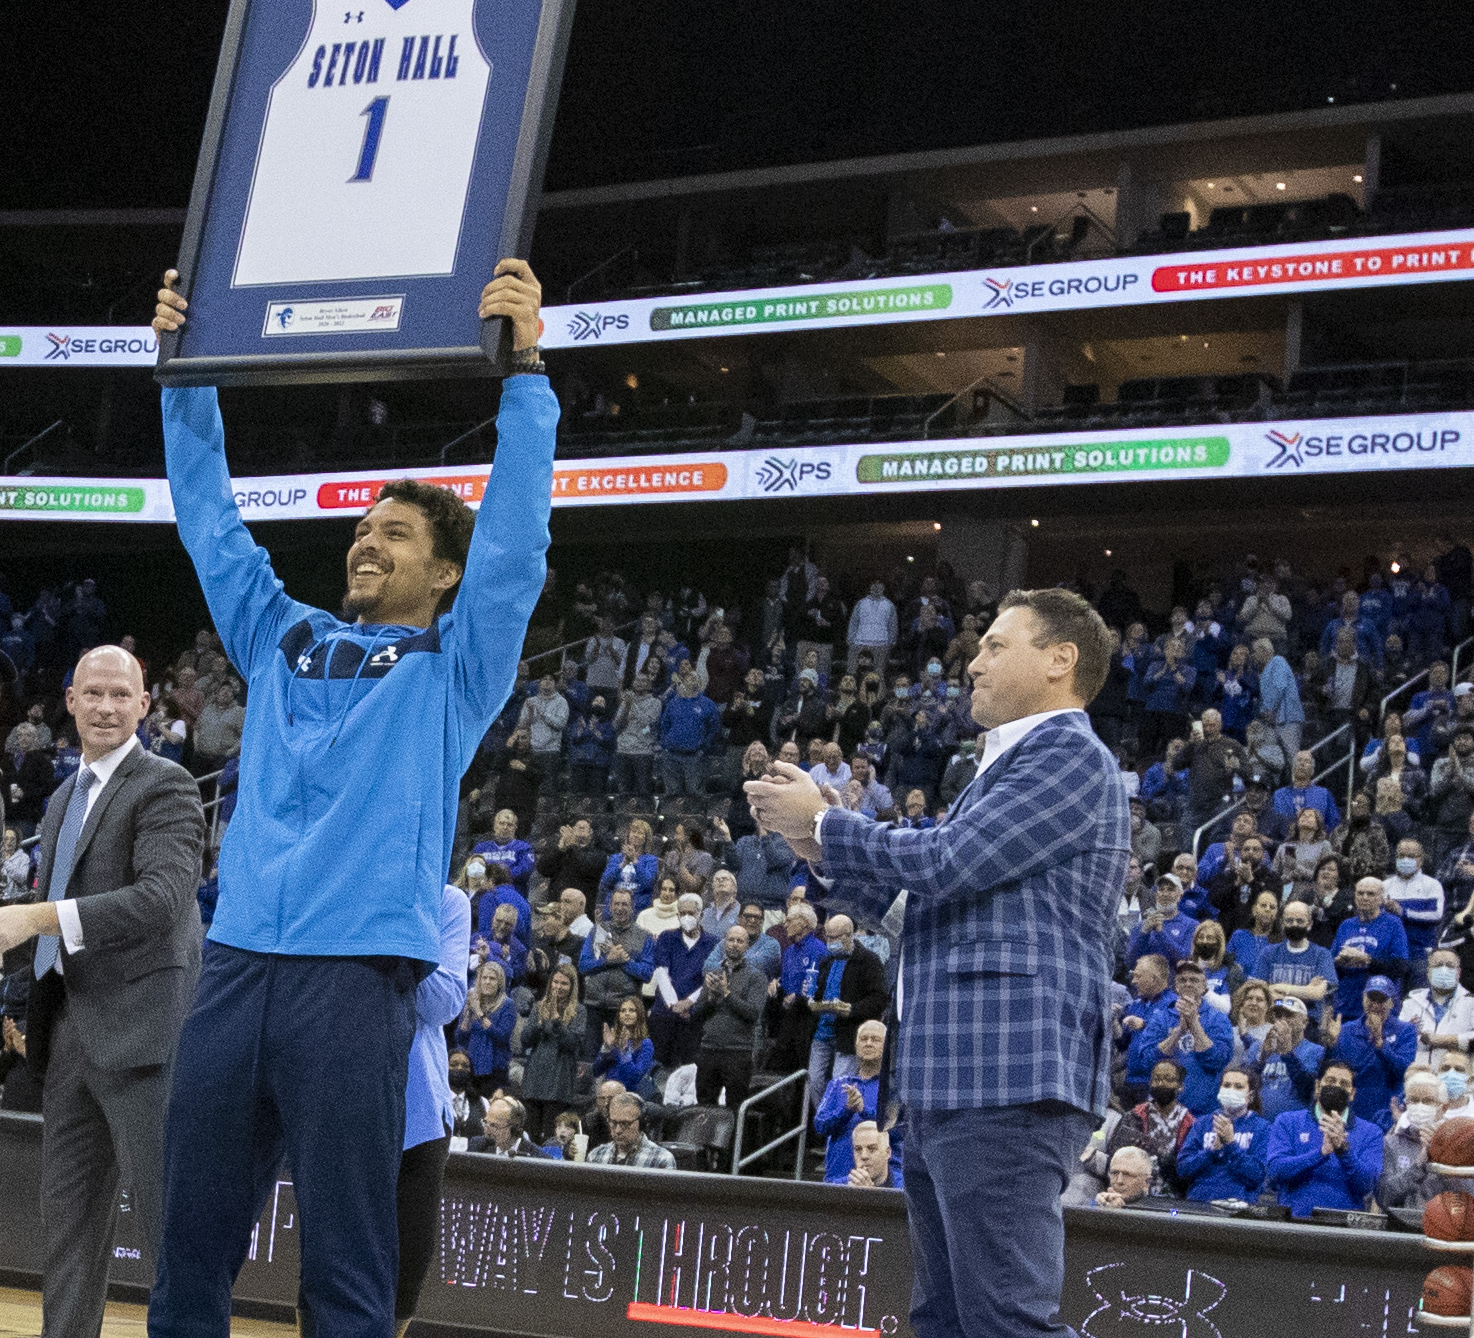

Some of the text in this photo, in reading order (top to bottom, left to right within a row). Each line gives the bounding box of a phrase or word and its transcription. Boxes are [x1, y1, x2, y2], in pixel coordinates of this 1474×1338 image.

[307, 33, 460, 88] SETON HALL
[345, 94, 392, 183] 1
[1176, 268, 1217, 287] THE
[1226, 258, 1343, 282] KEYSTONE
[1354, 255, 1382, 271] TO
[1391, 249, 1460, 270] PRINT
[670, 307, 756, 327] MANAGED
[763, 301, 819, 319] PRINT
[826, 292, 934, 313] SOLUTIONS
[881, 455, 989, 477] MANAGED
[995, 451, 1065, 471] PRINT
[1072, 445, 1208, 468] SOLUTIONS
[337, 487, 371, 502] THE
[577, 470, 704, 490] EXCELLENCE
[23, 491, 129, 507] SOLUTIONS
